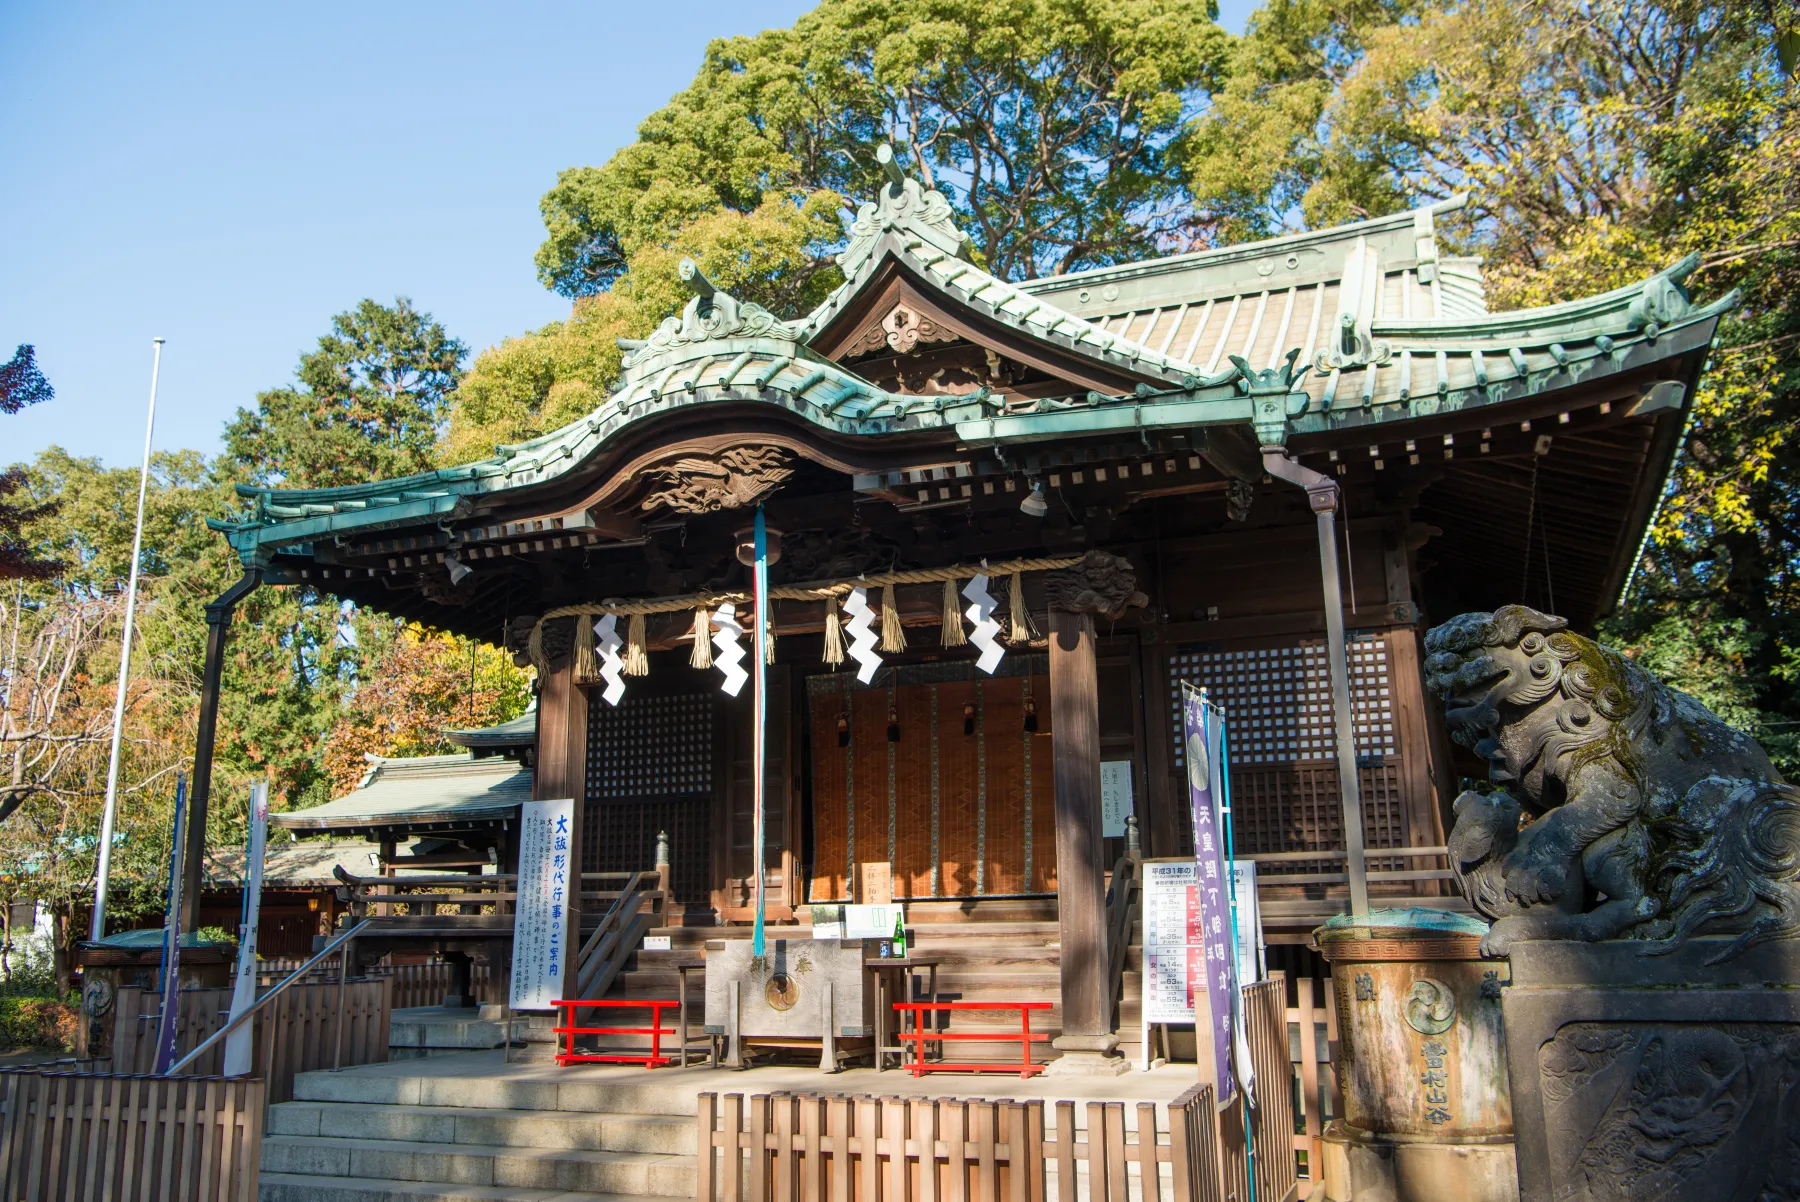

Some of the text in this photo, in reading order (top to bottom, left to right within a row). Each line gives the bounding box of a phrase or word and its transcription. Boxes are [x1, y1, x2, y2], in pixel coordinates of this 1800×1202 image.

[548, 814, 568, 976] 大祓形代行事のご案内
